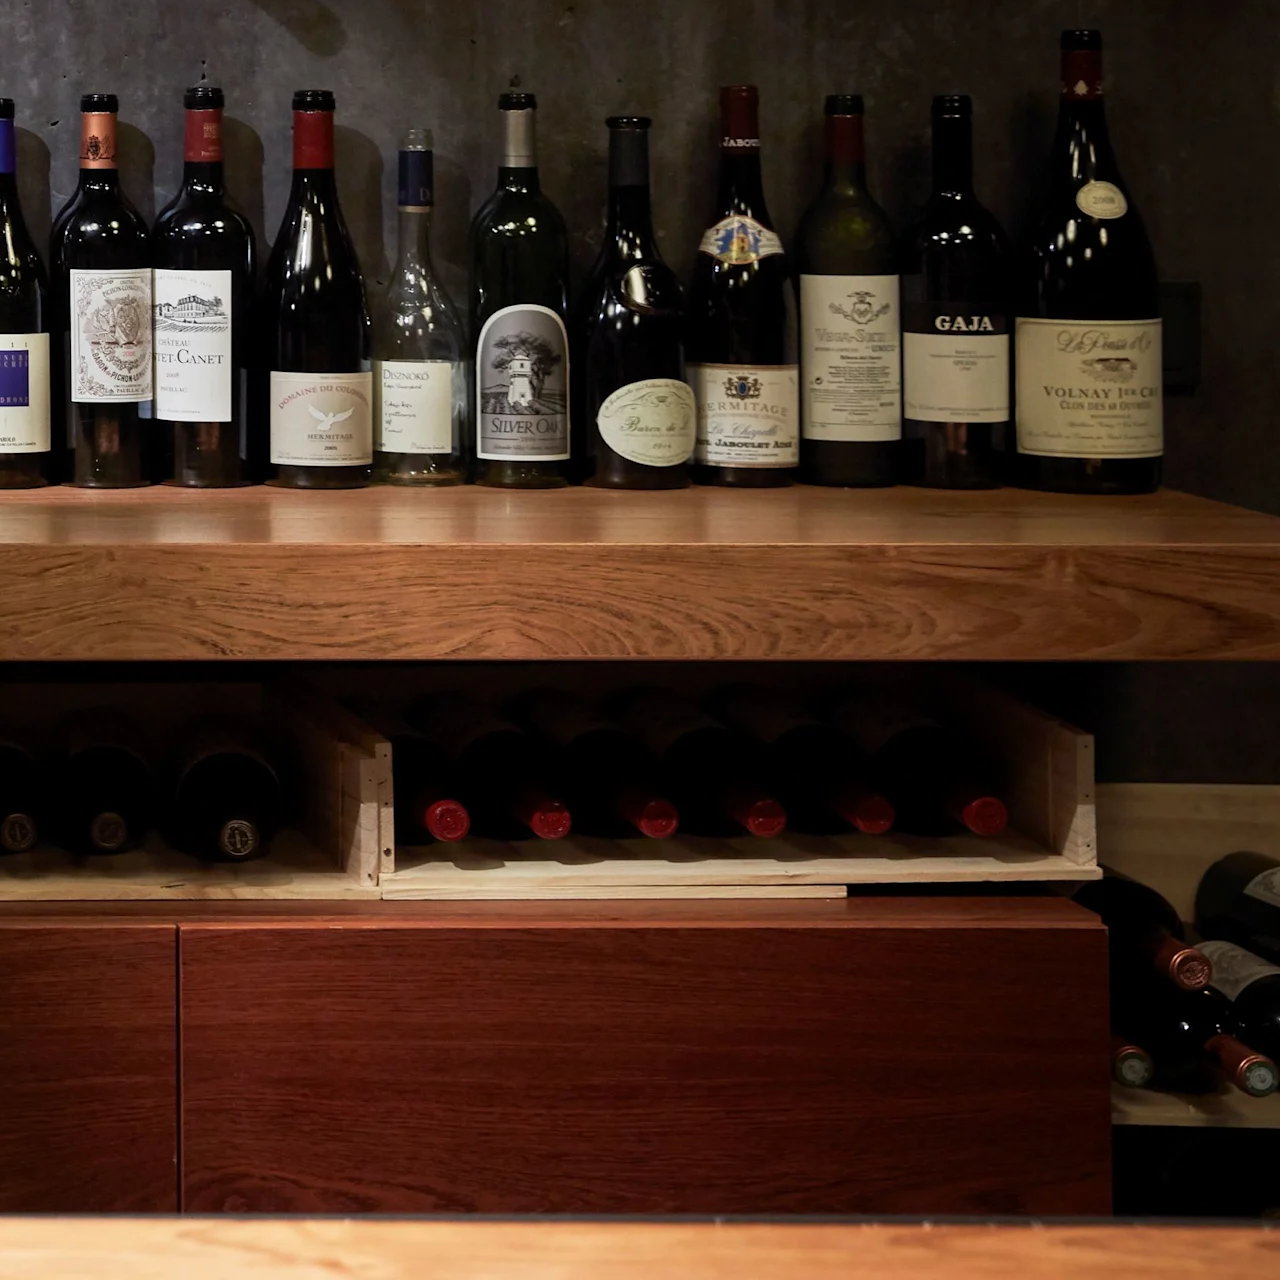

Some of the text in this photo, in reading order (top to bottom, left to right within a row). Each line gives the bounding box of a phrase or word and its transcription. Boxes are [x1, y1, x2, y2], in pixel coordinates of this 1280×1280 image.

[934, 315, 995, 331] GAJA
[91, 352, 109, 374] BARON
[278, 386, 318, 410] DOMAINE
[1042, 385, 1113, 399] VOLNAY
[1059, 400, 1086, 411] CLOS
[1086, 401, 1106, 410] DES
[491, 417, 535, 435] SILVER
[714, 438, 771, 449] JABOULET
